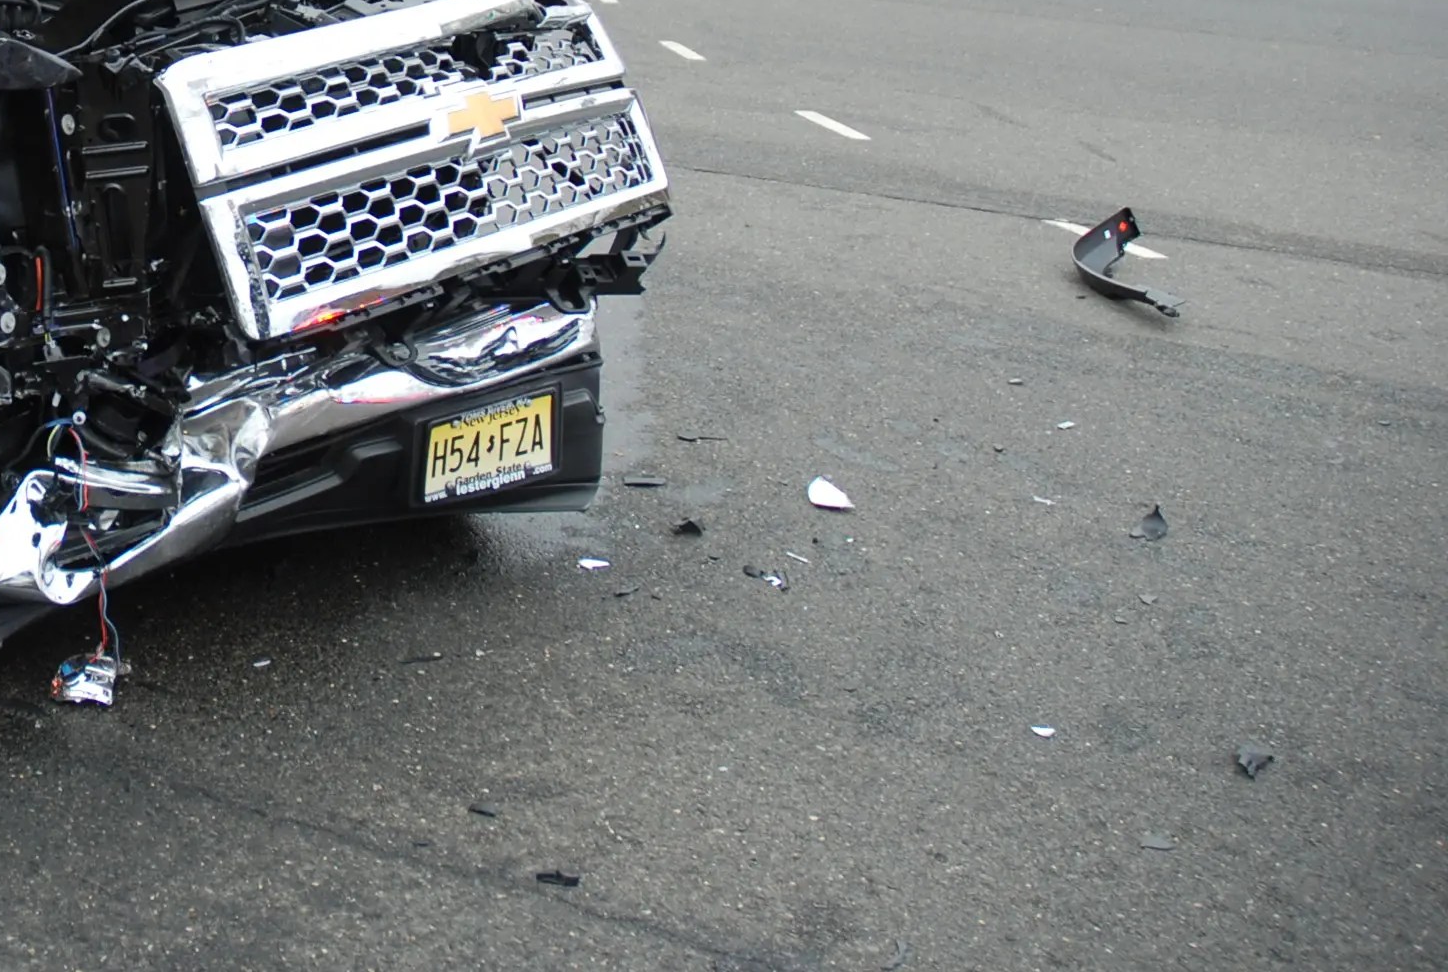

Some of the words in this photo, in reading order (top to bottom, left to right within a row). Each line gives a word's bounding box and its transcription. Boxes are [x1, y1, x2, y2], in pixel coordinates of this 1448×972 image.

[431, 431, 481, 478] H54
[498, 414, 544, 462] FZA
[455, 471, 492, 485] Garden
[496, 462, 522, 475] State
[456, 470, 526, 496] lesterglenn
